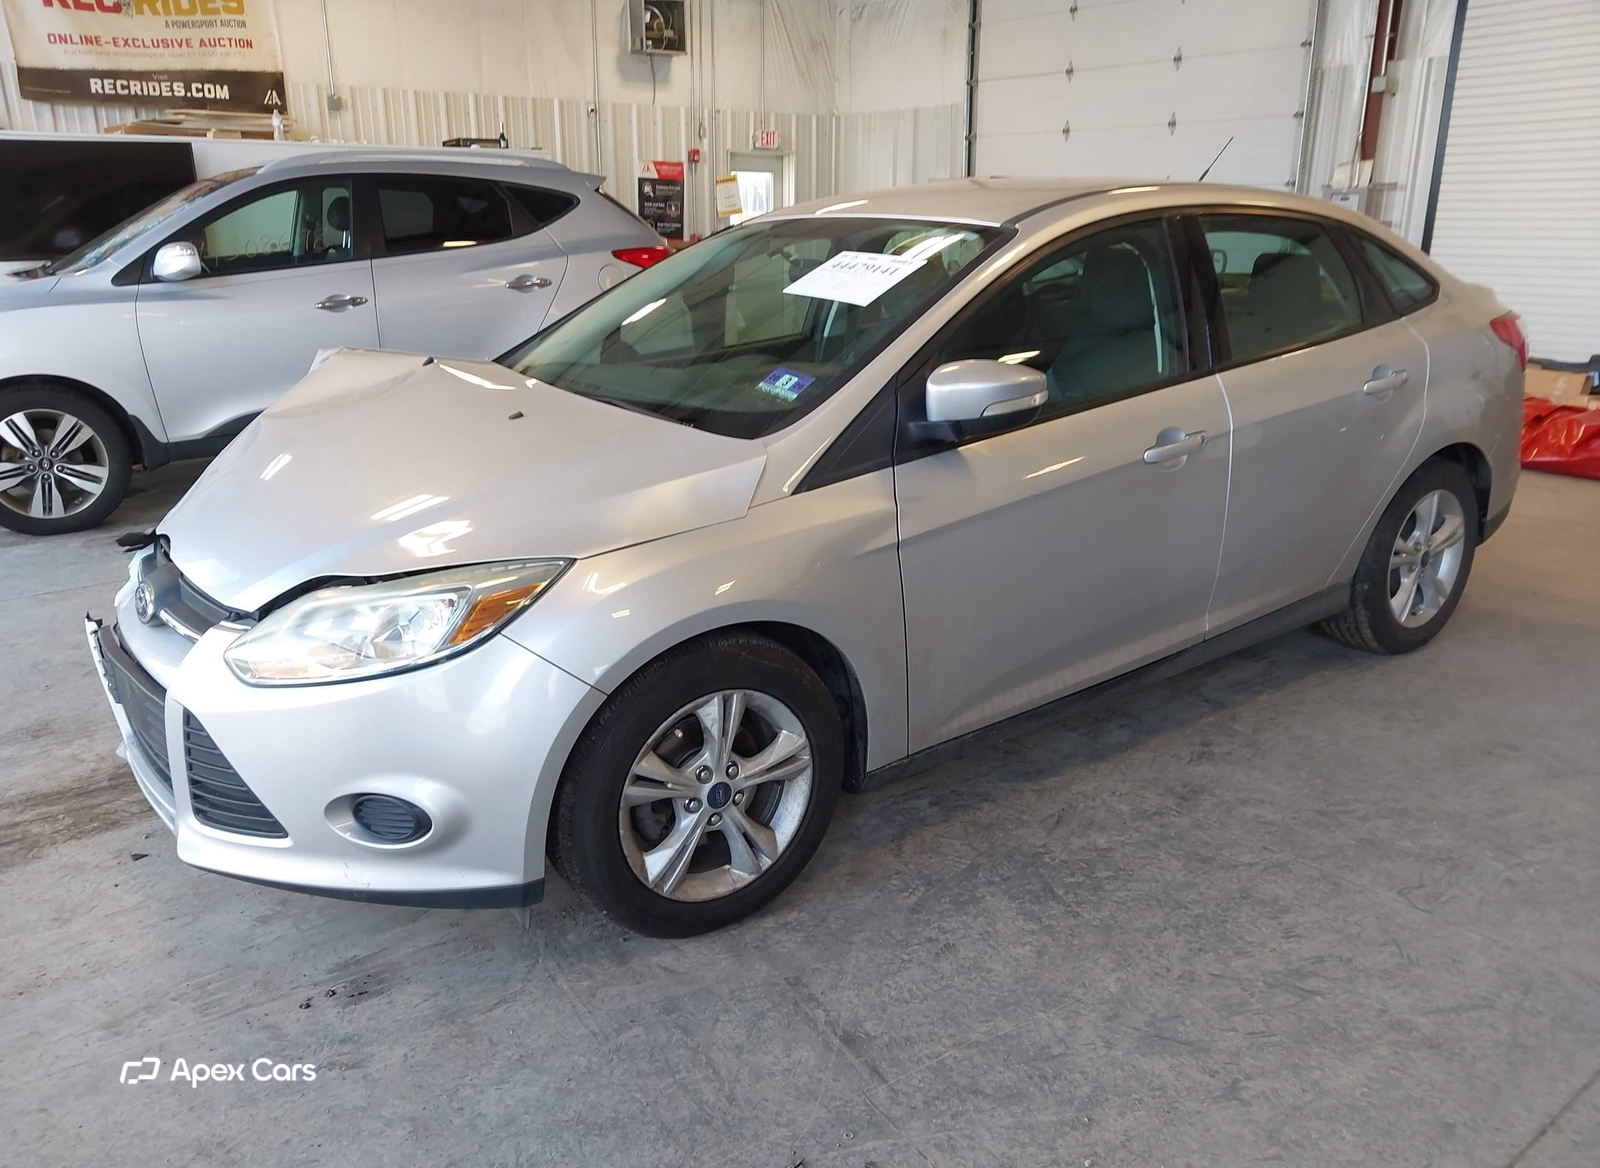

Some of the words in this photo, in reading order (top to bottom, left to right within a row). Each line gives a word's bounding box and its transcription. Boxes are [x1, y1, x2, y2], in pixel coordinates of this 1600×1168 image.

[164, 20, 171, 29] A
[171, 20, 218, 29] POWERSPORT
[220, 19, 247, 29] AUCTION
[47, 33, 194, 48] ONLINE-EXCLUSIVE
[198, 37, 254, 49] AUCTION
[89, 77, 230, 100] RECRIDES.COM
[761, 131, 775, 147] EXIT
